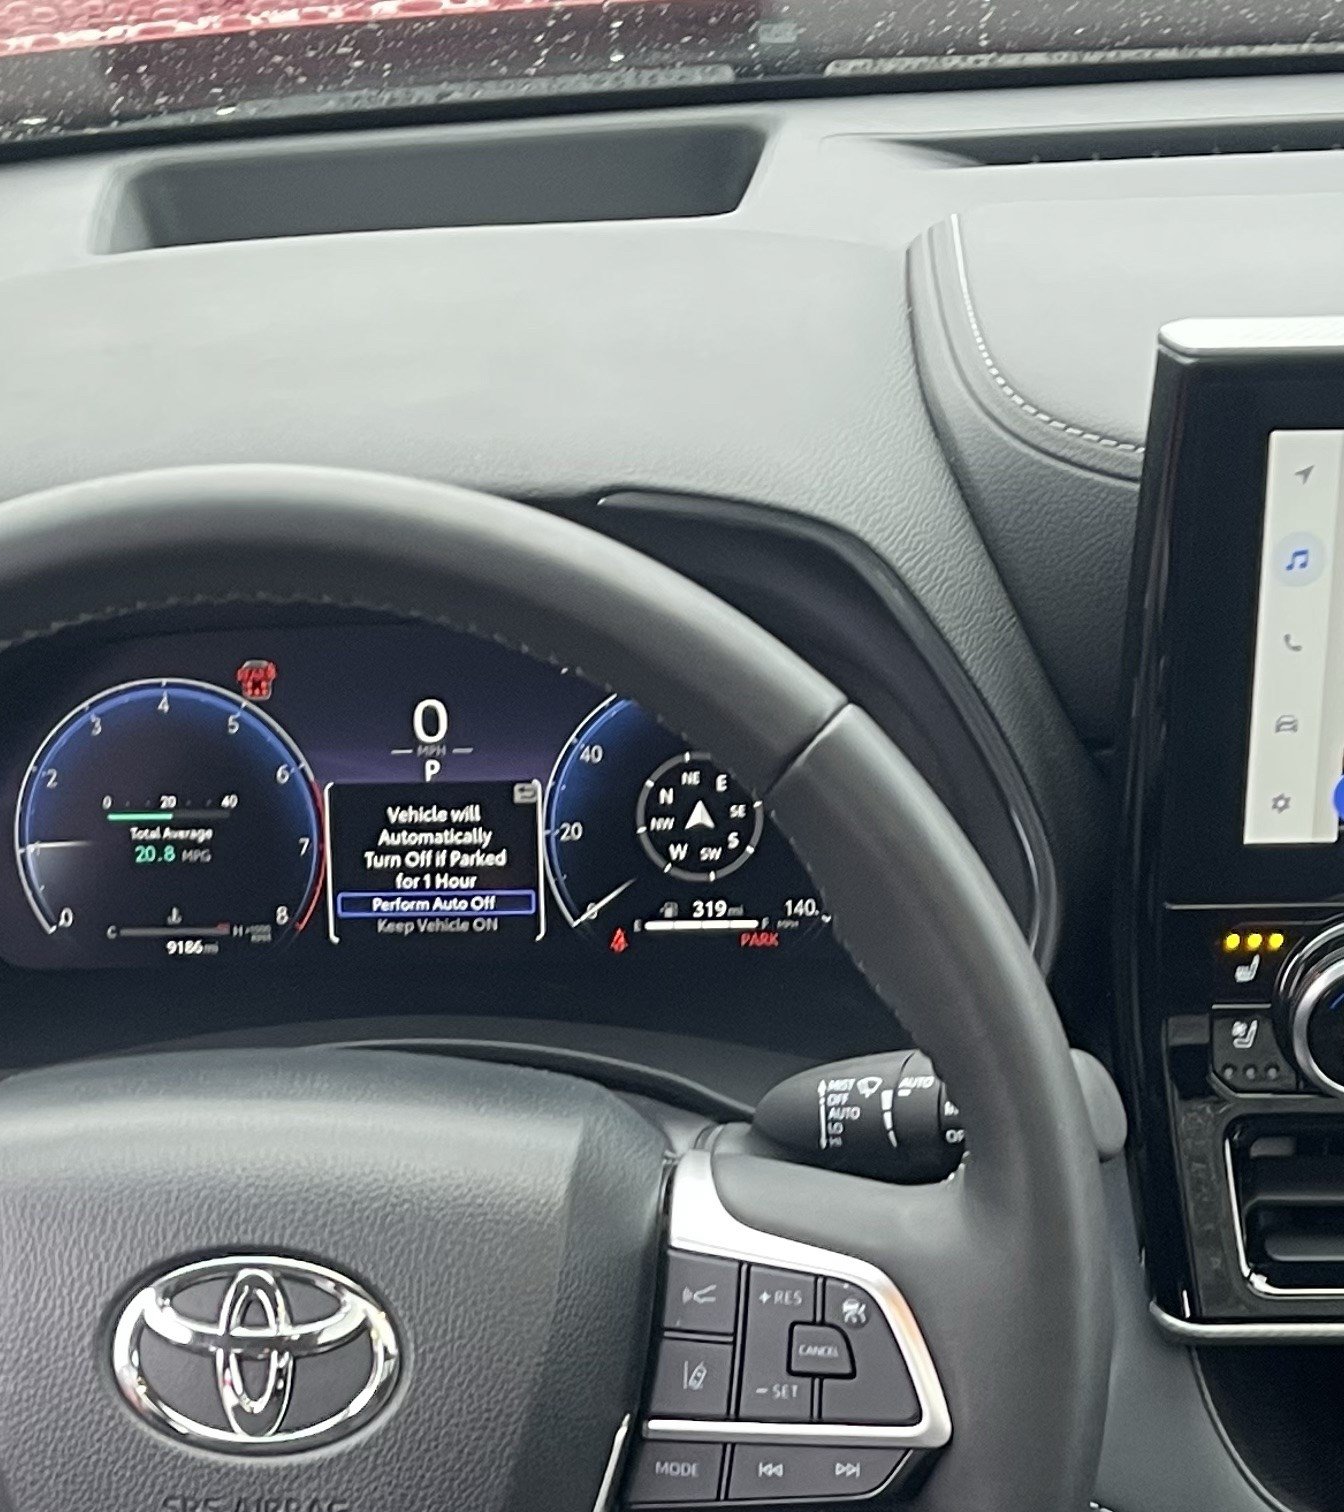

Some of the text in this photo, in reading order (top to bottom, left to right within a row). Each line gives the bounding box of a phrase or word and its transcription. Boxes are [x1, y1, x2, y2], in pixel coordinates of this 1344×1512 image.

[157, 695, 170, 714] 4
[90, 716, 103, 737] 3
[227, 715, 240, 735] 5
[413, 698, 448, 743] 0
[417, 744, 447, 757] MPH
[579, 744, 604, 764] 40
[46, 767, 59, 789] 2
[276, 765, 290, 785] 6
[424, 758, 441, 782] P
[681, 770, 700, 786] NE
[715, 773, 728, 792] E
[102, 794, 238, 809] 0 20 40
[658, 787, 674, 805] N
[387, 804, 481, 824] Vehicle will
[729, 804, 746, 818] SE
[560, 821, 583, 841] 20
[649, 816, 675, 831] NW
[129, 827, 214, 844] Total Average
[377, 827, 493, 849] Automatically
[727, 831, 740, 849] S
[134, 845, 212, 863] 20.8 MPG
[299, 837, 310, 857] 7
[668, 843, 689, 861] W
[700, 846, 722, 861] SW
[364, 848, 508, 869] Turn Off if Parked
[395, 872, 477, 889] for 1 Hour
[372, 895, 496, 912] Perform Auto Off
[692, 900, 728, 918] 319
[784, 898, 816, 916] 140
[60, 907, 74, 928] 0
[276, 906, 289, 926] 8
[107, 924, 244, 939] C H
[377, 917, 498, 935] Keep Vehicle ON
[166, 940, 204, 955] 9186
[740, 932, 779, 947] PARK
[898, 1075, 935, 1089] AUTO
[827, 1092, 849, 1105] OFF
[828, 1106, 860, 1120] AUTO
[827, 1121, 844, 1135] LO
[798, 1344, 840, 1358] CANCEL
[655, 1461, 700, 1478] MODE
